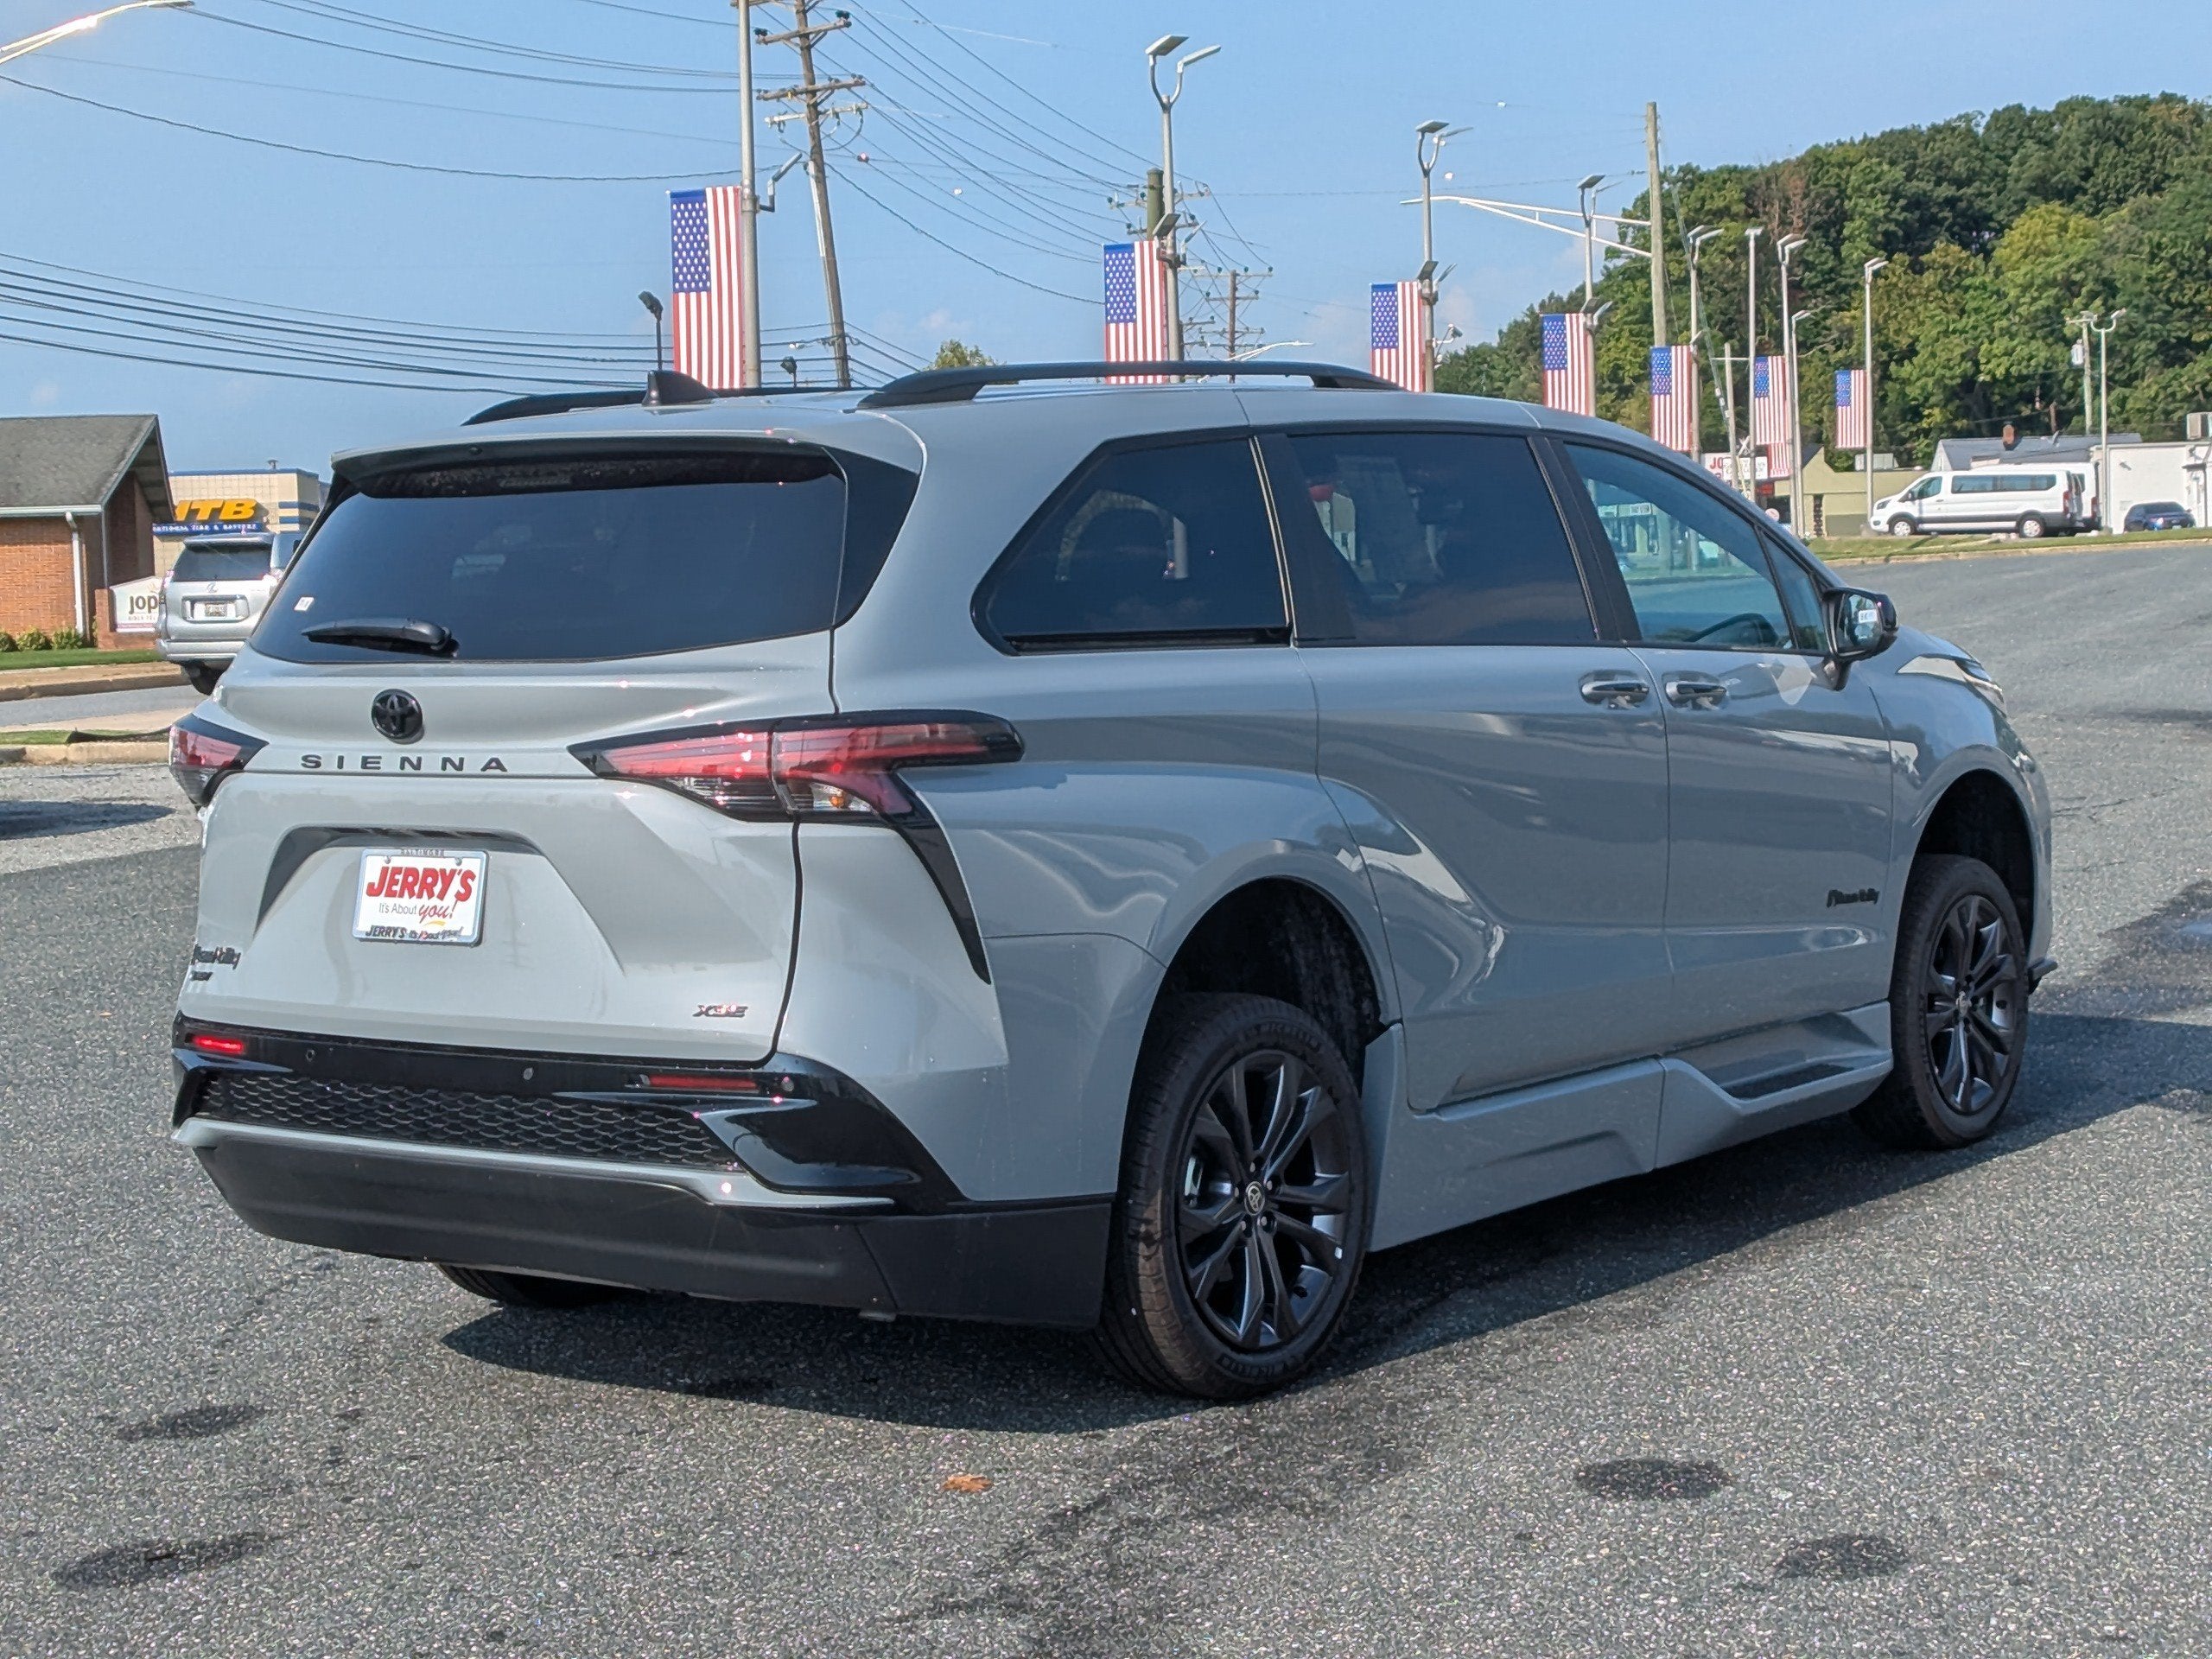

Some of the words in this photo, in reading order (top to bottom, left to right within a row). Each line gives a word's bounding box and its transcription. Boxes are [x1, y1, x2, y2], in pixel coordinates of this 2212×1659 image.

[301, 753, 508, 772] SIENNA
[365, 866, 476, 902] JERRY'S
[378, 902, 390, 913] It's
[391, 903, 416, 915] About
[418, 900, 458, 924] you!
